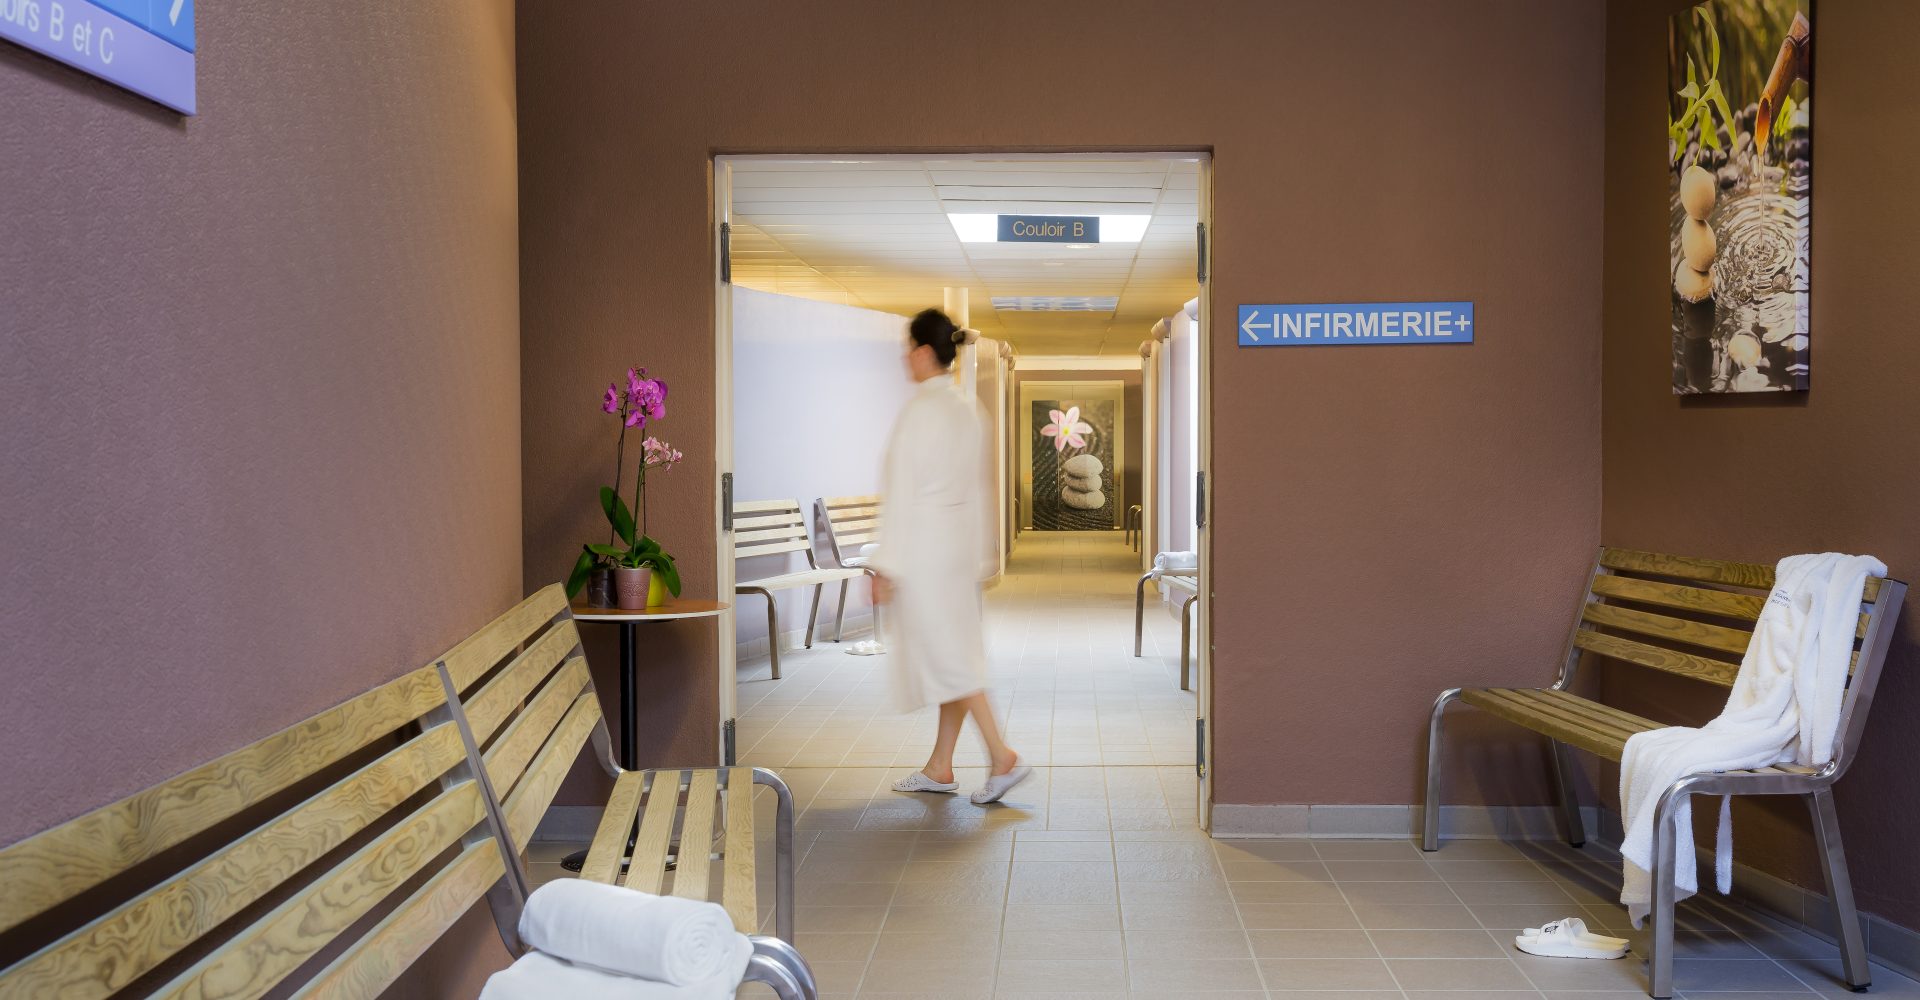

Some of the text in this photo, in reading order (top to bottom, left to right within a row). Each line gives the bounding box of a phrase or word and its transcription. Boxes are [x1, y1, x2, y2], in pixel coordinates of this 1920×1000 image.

[0, 0, 114, 64] oirs B et C
[1013, 221, 1084, 237] Couloir B
